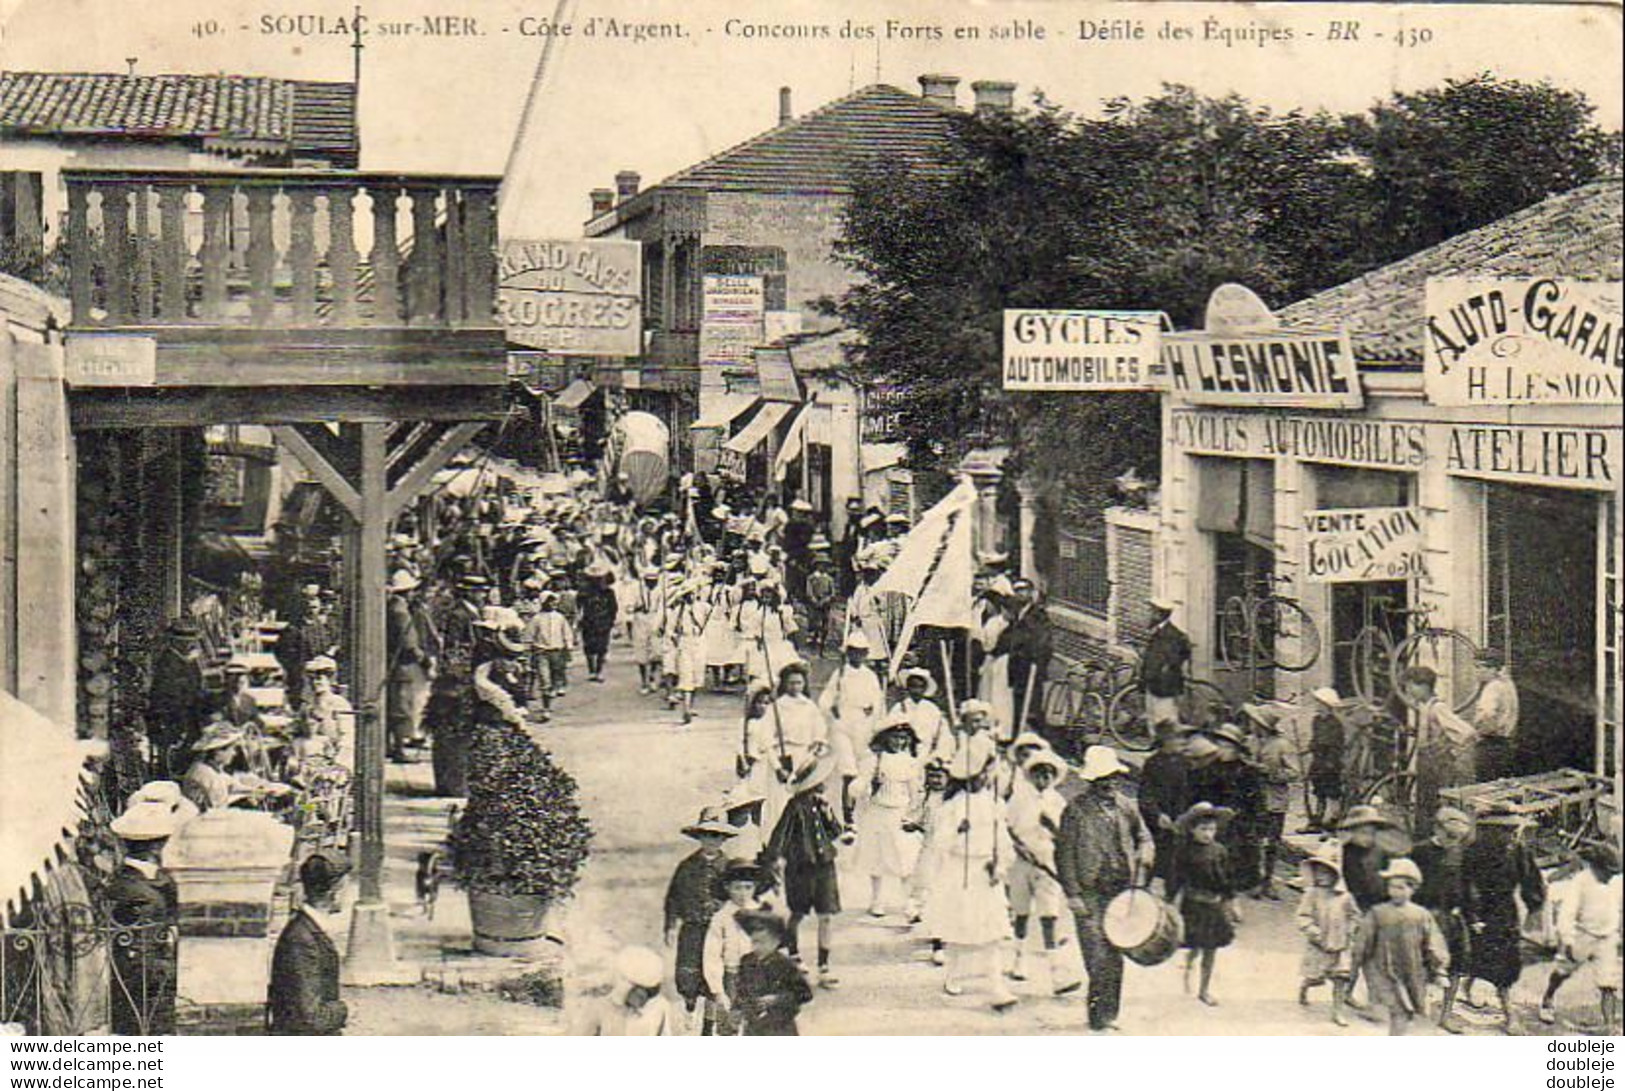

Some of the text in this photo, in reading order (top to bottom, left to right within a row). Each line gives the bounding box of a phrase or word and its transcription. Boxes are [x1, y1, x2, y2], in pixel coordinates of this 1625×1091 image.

[498, 243, 569, 282] RAND
[497, 298, 634, 329] ROGRES
[1013, 313, 1142, 345] CYCLES
[1007, 356, 1140, 383] AUTOMOBILES
[1193, 340, 1349, 393] LESMONIE
[1174, 414, 1427, 467] CYCLES AUTOMOBILES
[1446, 427, 1612, 481] ATELIER
[1303, 513, 1365, 532] VENTE
[1306, 510, 1419, 576] LOCATION
